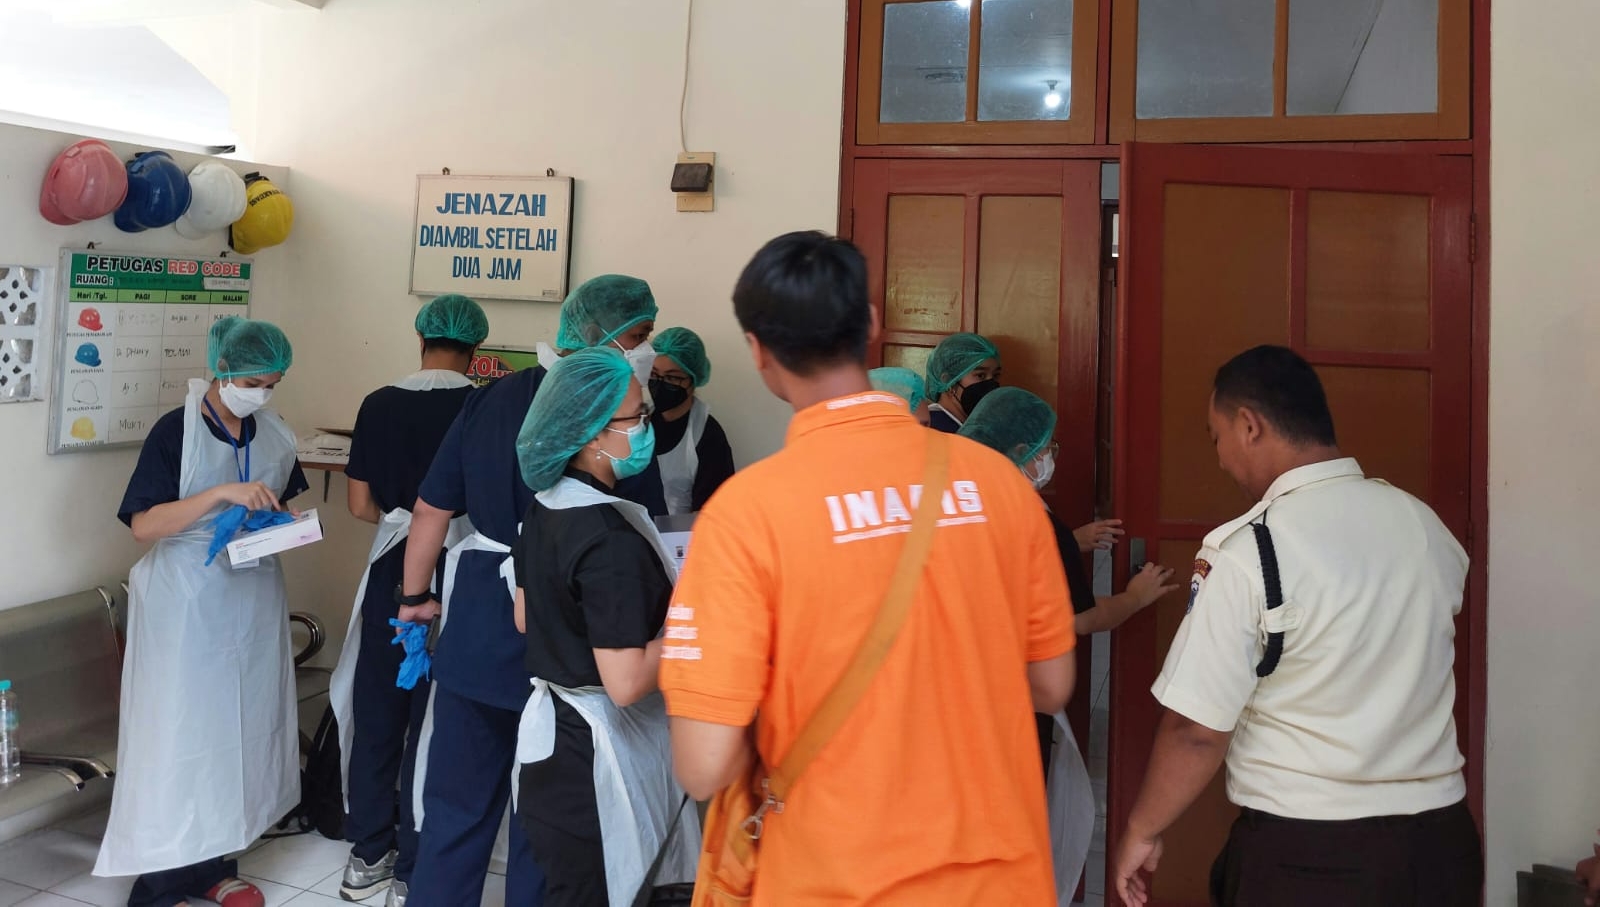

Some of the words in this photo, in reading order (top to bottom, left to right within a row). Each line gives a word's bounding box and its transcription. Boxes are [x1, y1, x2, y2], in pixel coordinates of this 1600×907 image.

[436, 192, 547, 217] JENAZAH
[419, 225, 483, 249] DIAMBIL
[485, 227, 557, 251] SETELAH
[87, 256, 163, 273] PETUGAS
[168, 260, 198, 275] RED
[202, 262, 240, 276] CODE
[452, 255, 481, 279] DUA
[487, 257, 522, 280] JAM
[134, 292, 151, 301] PAGI
